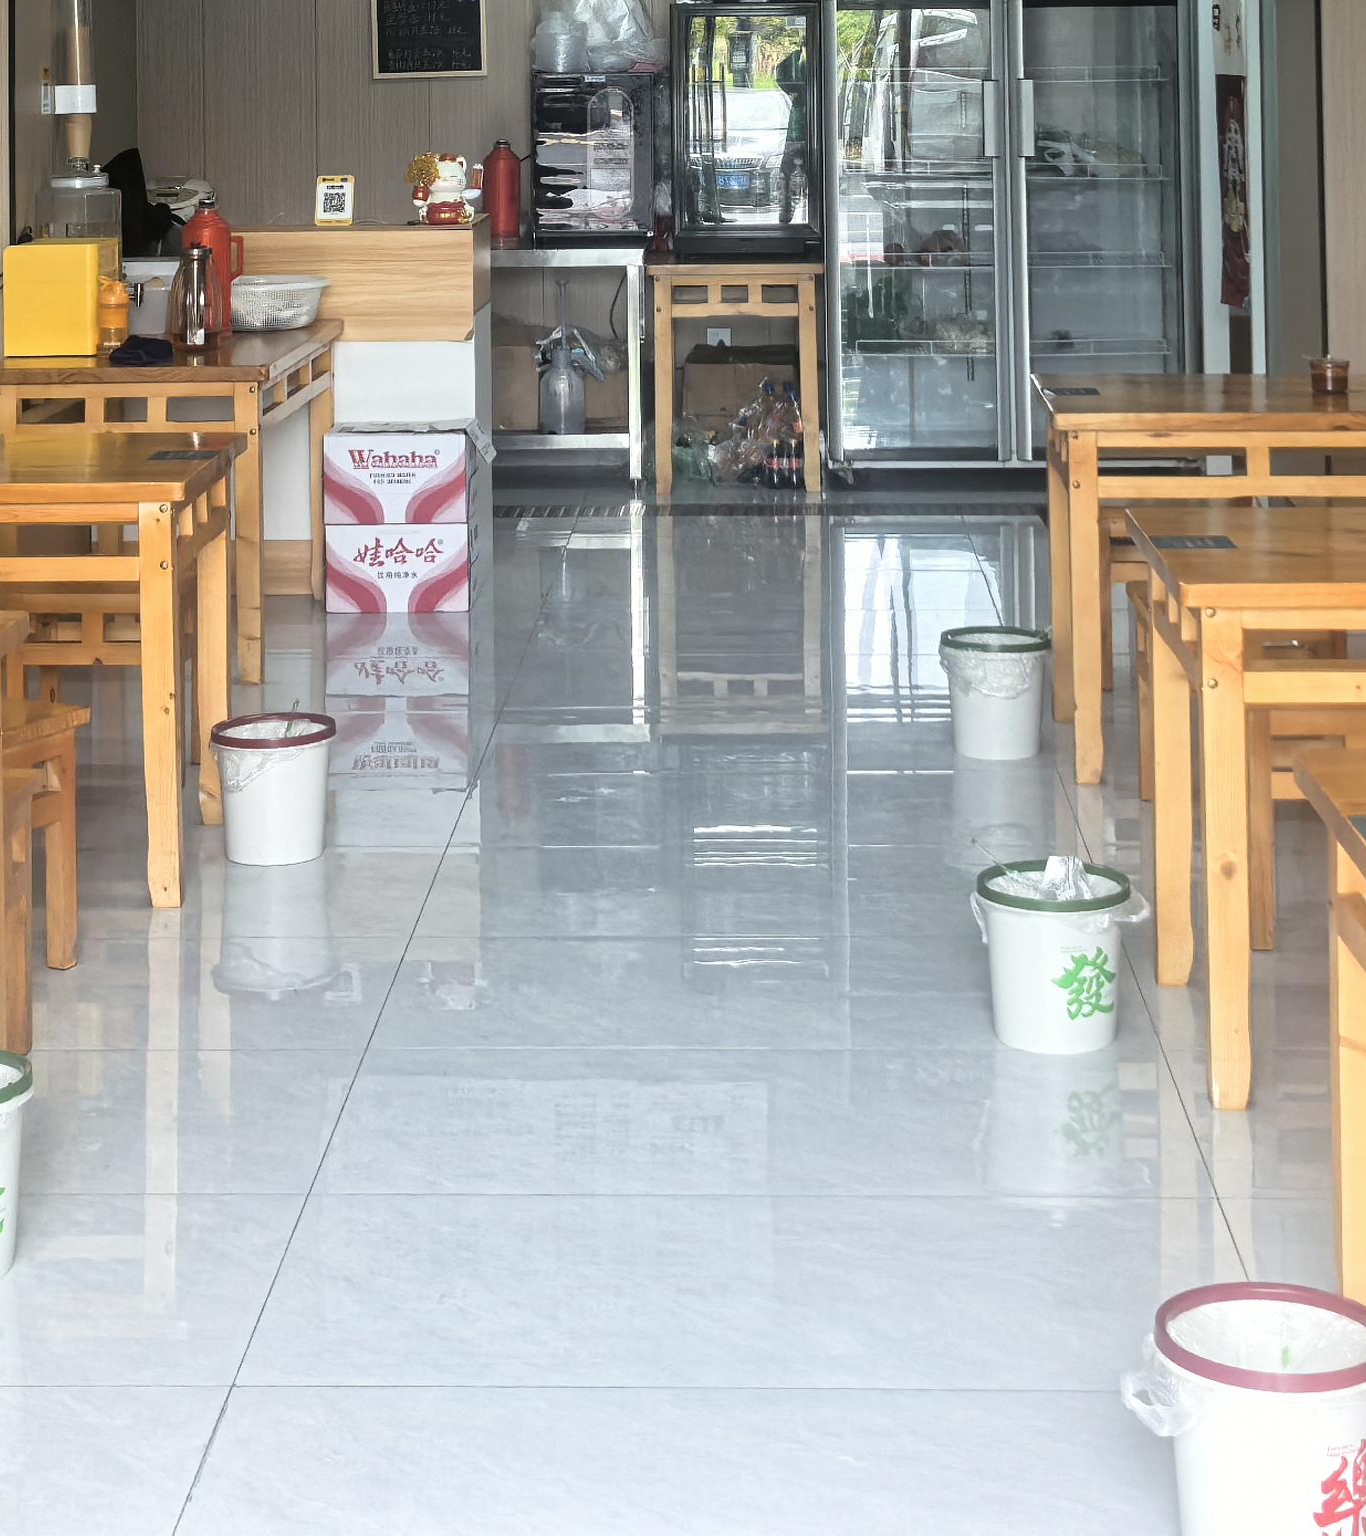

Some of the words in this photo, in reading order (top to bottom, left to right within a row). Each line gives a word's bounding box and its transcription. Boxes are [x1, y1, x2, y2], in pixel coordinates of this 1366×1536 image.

[348, 449, 438, 470] Wahaha
[353, 536, 444, 567] 娃哈哈
[377, 571, 419, 580] 饮用纯净水
